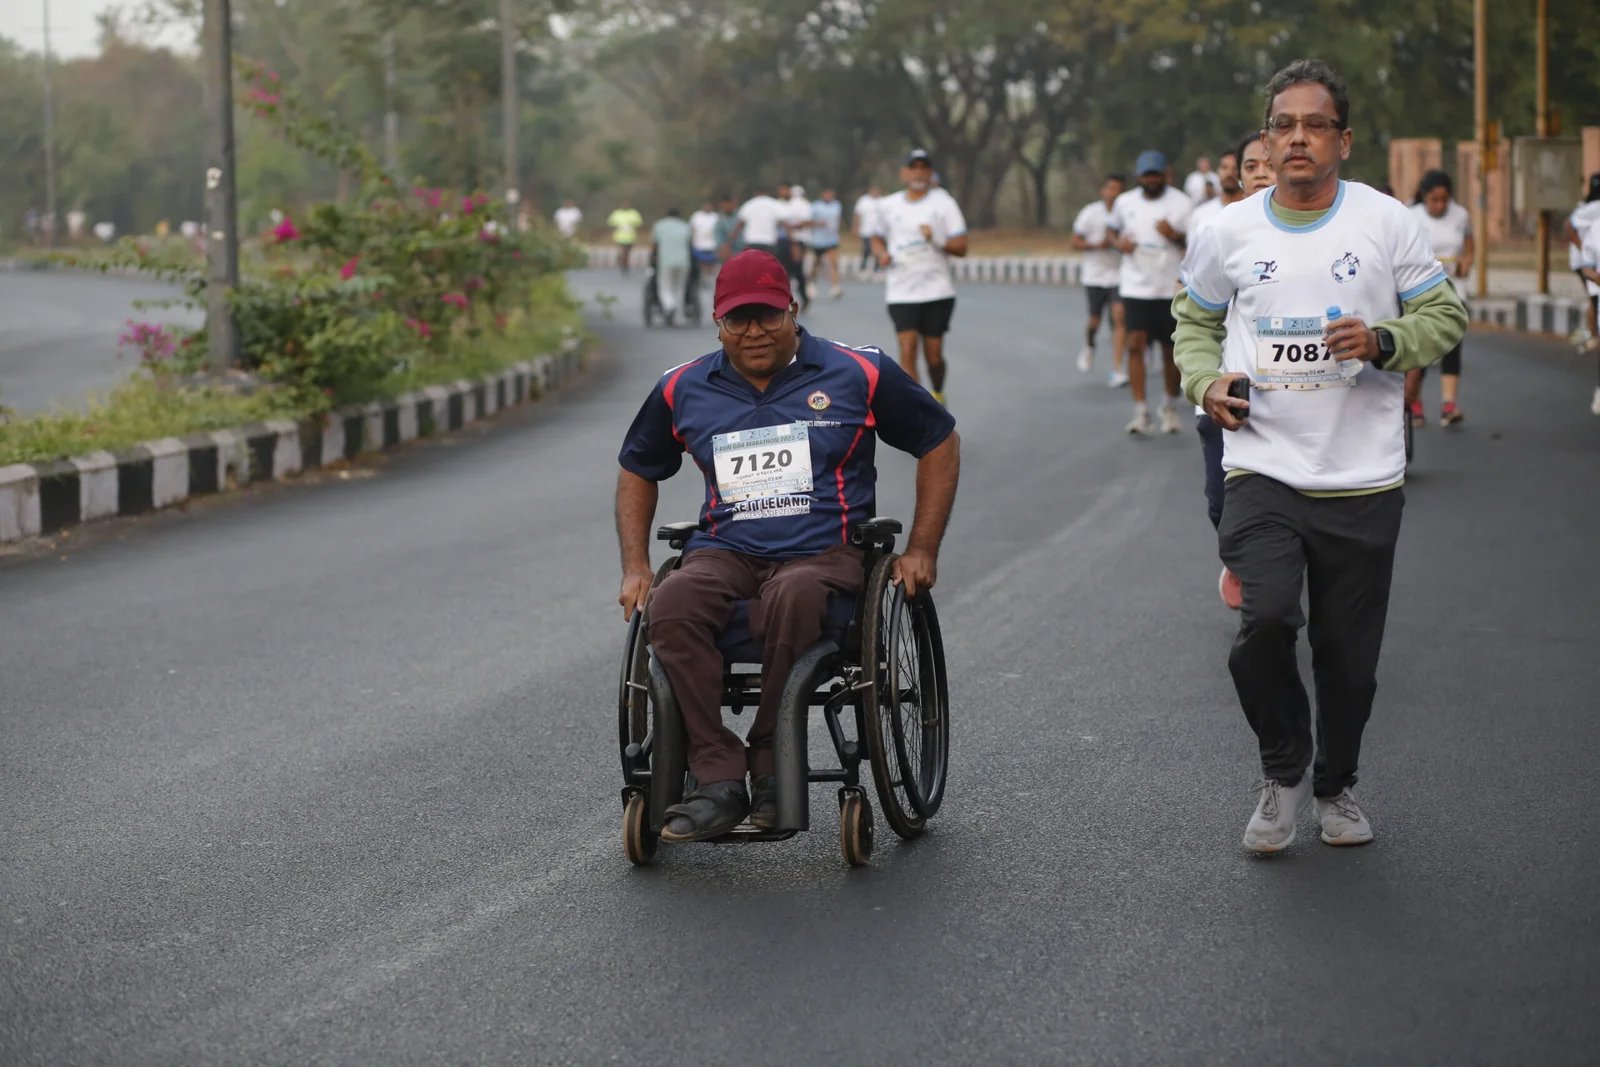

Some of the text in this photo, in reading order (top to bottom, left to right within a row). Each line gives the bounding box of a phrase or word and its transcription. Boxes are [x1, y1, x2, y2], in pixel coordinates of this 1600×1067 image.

[1272, 343, 1332, 363] 7087
[746, 437, 780, 448] MARATHON
[731, 449, 792, 475] 7120
